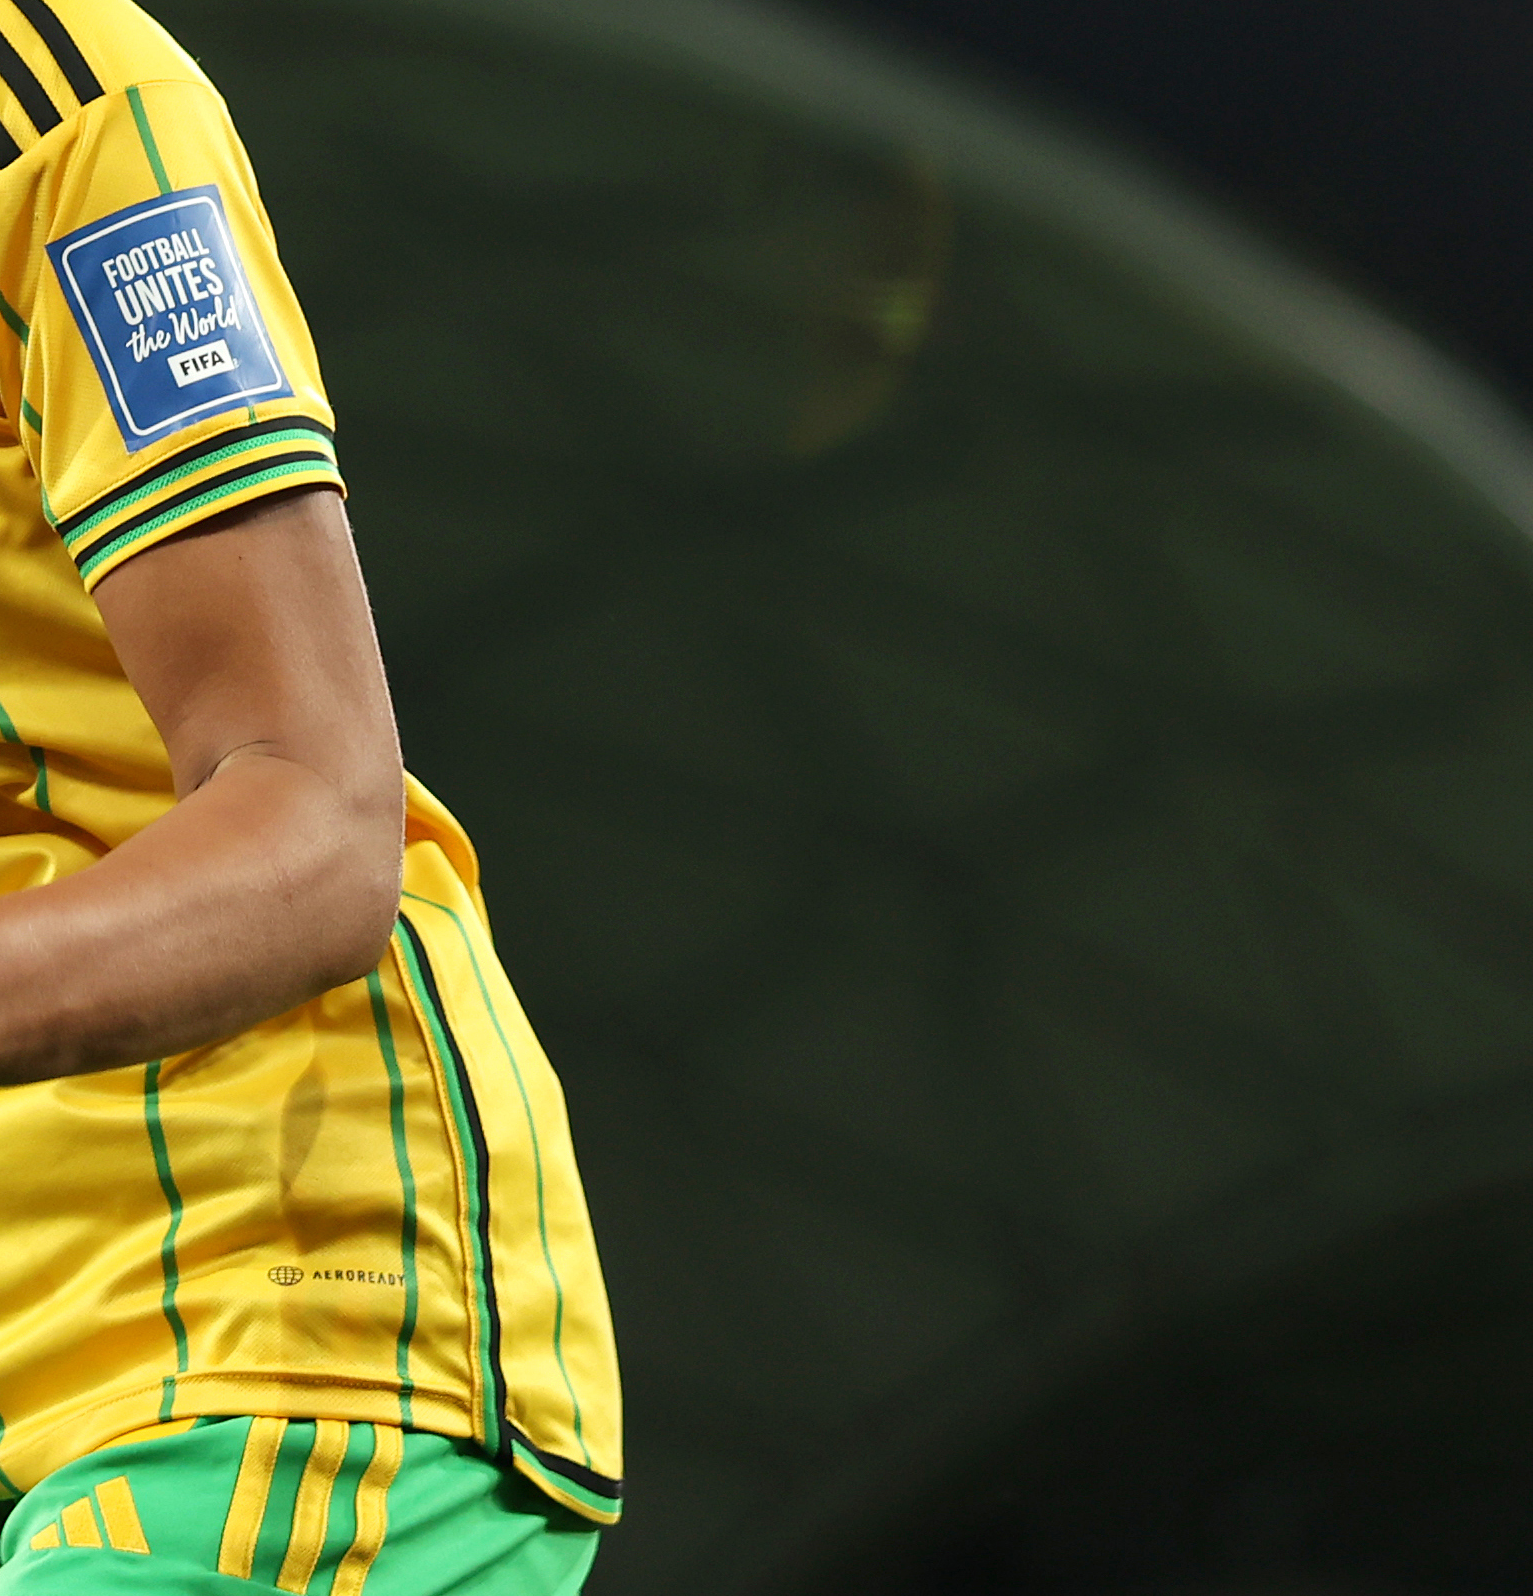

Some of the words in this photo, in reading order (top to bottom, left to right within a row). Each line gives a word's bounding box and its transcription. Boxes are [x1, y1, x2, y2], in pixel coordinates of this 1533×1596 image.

[102, 228, 210, 288] FOOTBALL
[114, 257, 223, 325] UNITES
[126, 324, 171, 362] the
[168, 295, 241, 344] World
[179, 351, 224, 375] FIFA
[312, 1270, 405, 1287] AEROREADY
